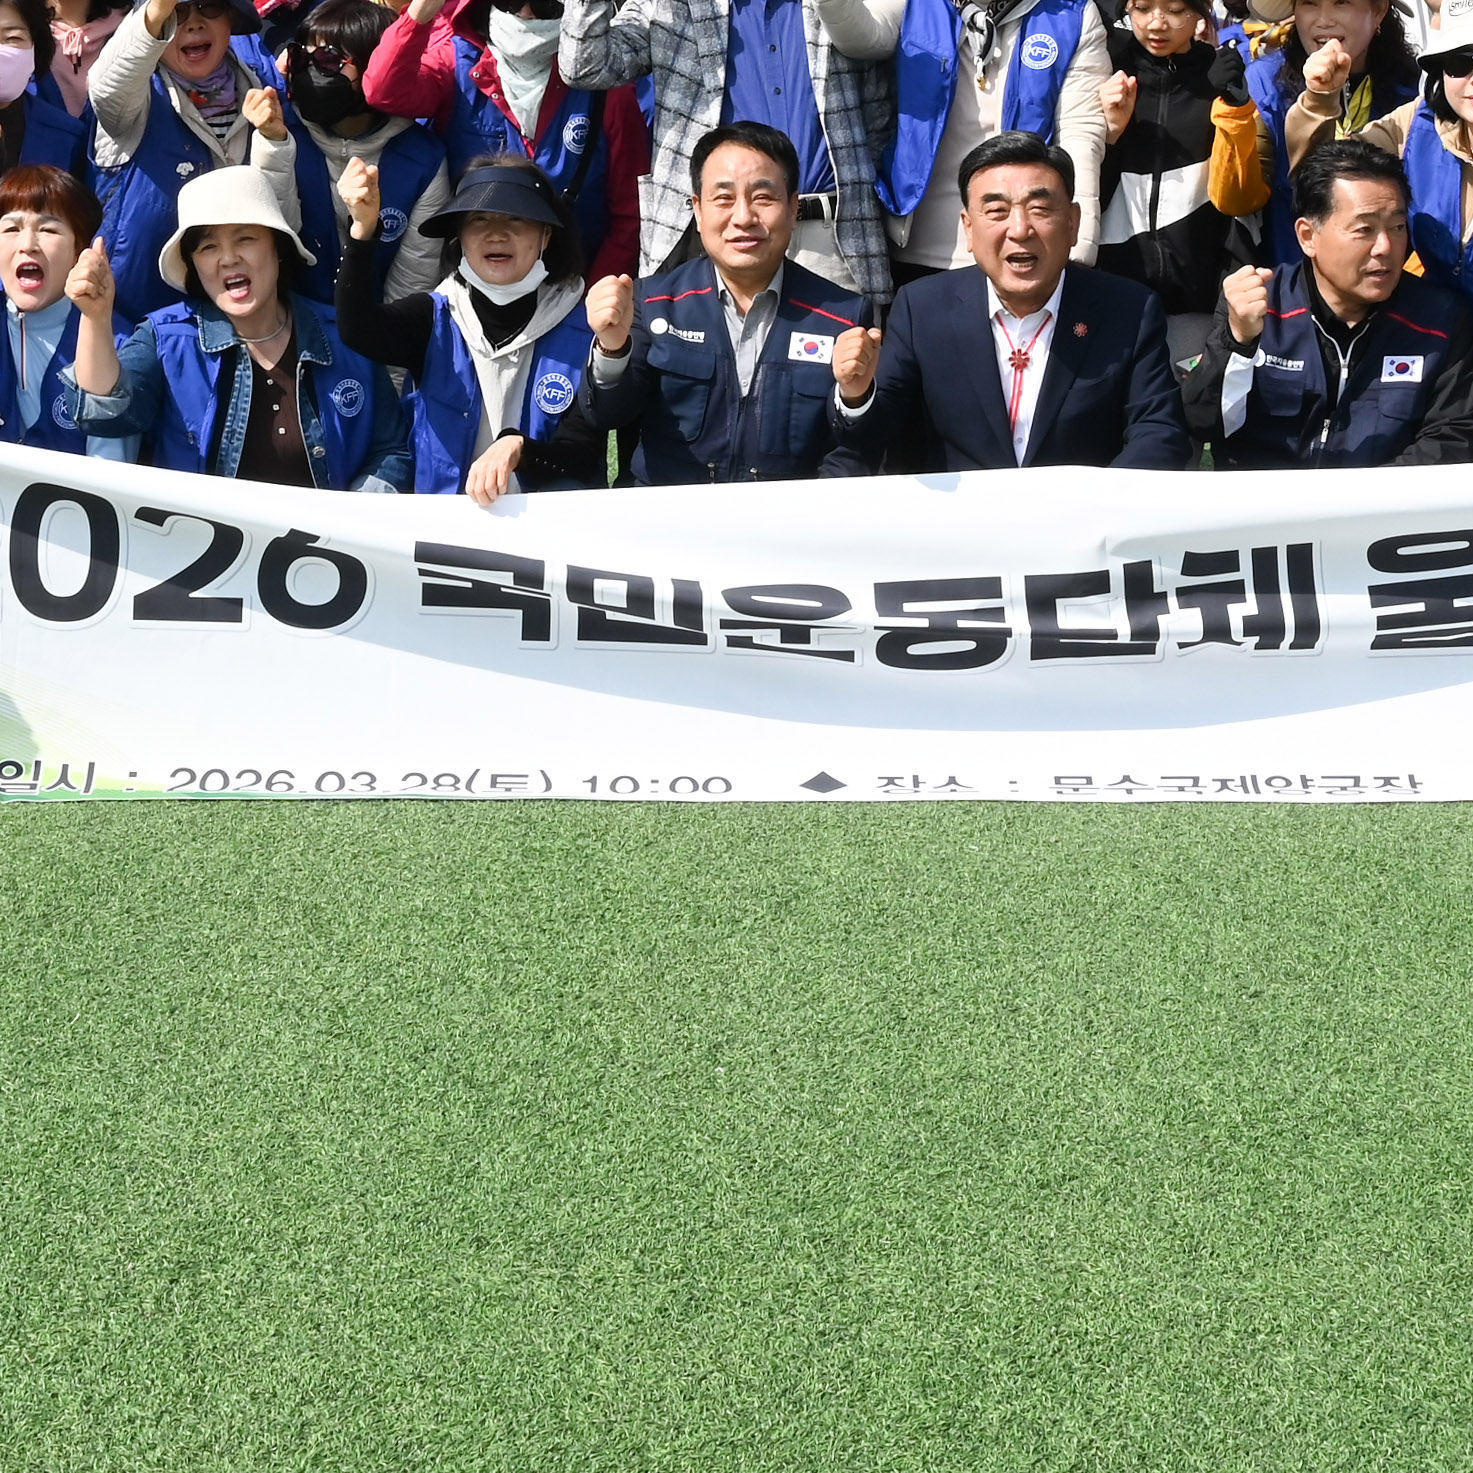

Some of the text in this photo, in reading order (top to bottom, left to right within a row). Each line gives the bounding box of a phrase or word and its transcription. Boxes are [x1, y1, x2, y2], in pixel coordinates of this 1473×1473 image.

[1029, 45, 1051, 59] KFF
[543, 386, 566, 401] KFF
[415, 540, 1323, 671] 국민운동단체
[582, 775, 732, 793] 10:00
[877, 775, 980, 794] 장소
